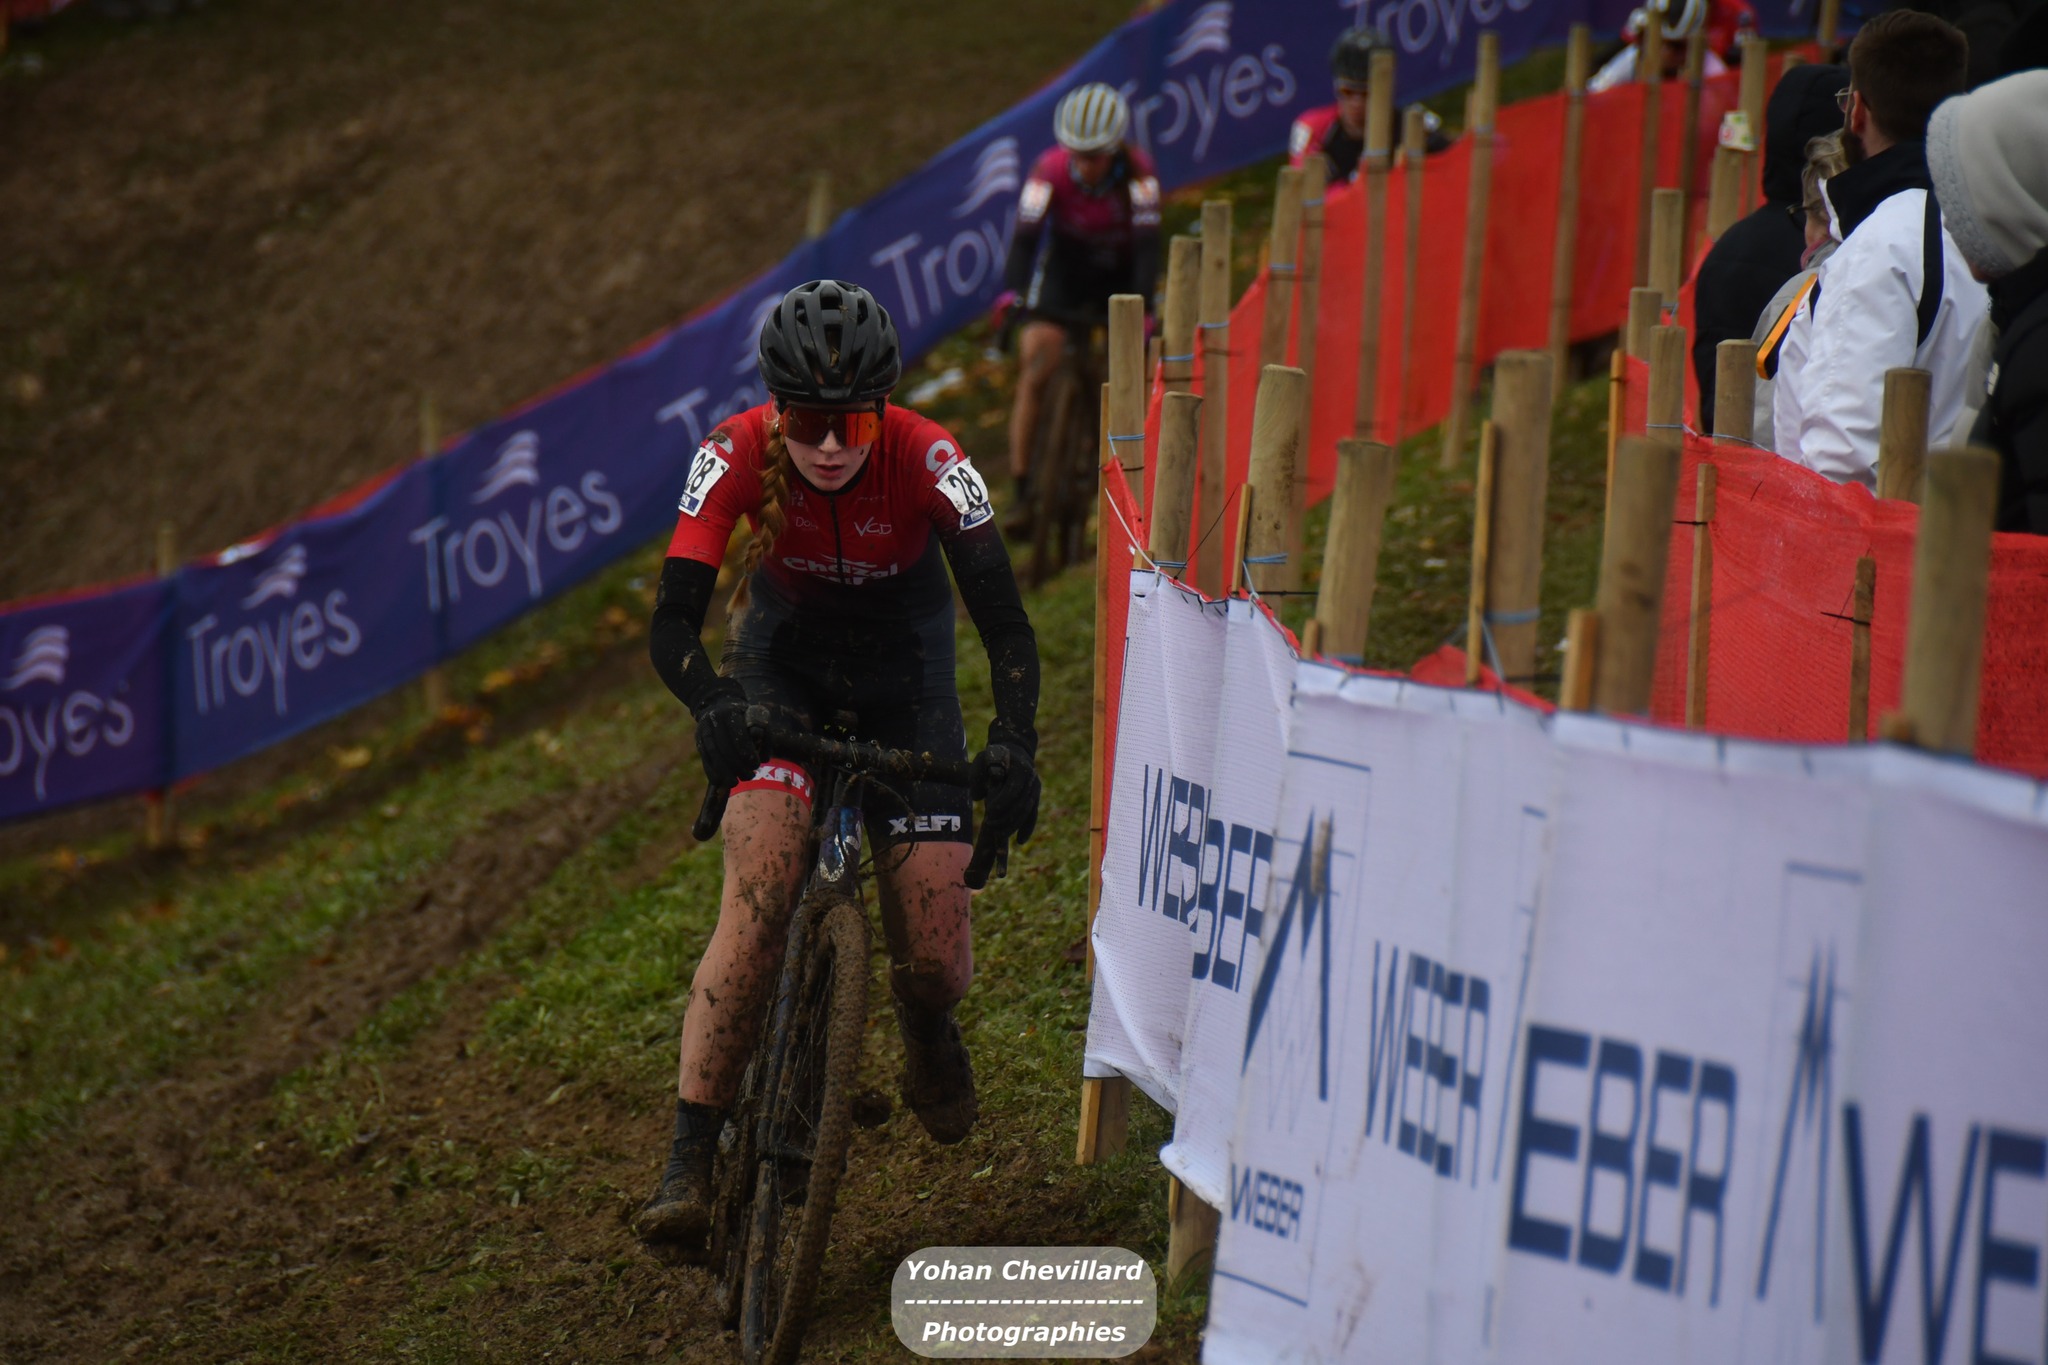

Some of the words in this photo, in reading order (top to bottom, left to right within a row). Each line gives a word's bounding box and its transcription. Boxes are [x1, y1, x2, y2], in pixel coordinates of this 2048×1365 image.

[869, 204, 1018, 329] Troy
[684, 452, 716, 494] 28
[947, 466, 983, 511] 28
[410, 470, 622, 612] Troyes
[186, 589, 362, 716] Troyes
[0, 690, 134, 800] oyes
[888, 815, 961, 836] XEFI
[1364, 939, 1490, 1189] WEBER
[1231, 1163, 1304, 1242] WEBER
[1507, 1022, 1738, 1308] EBER
